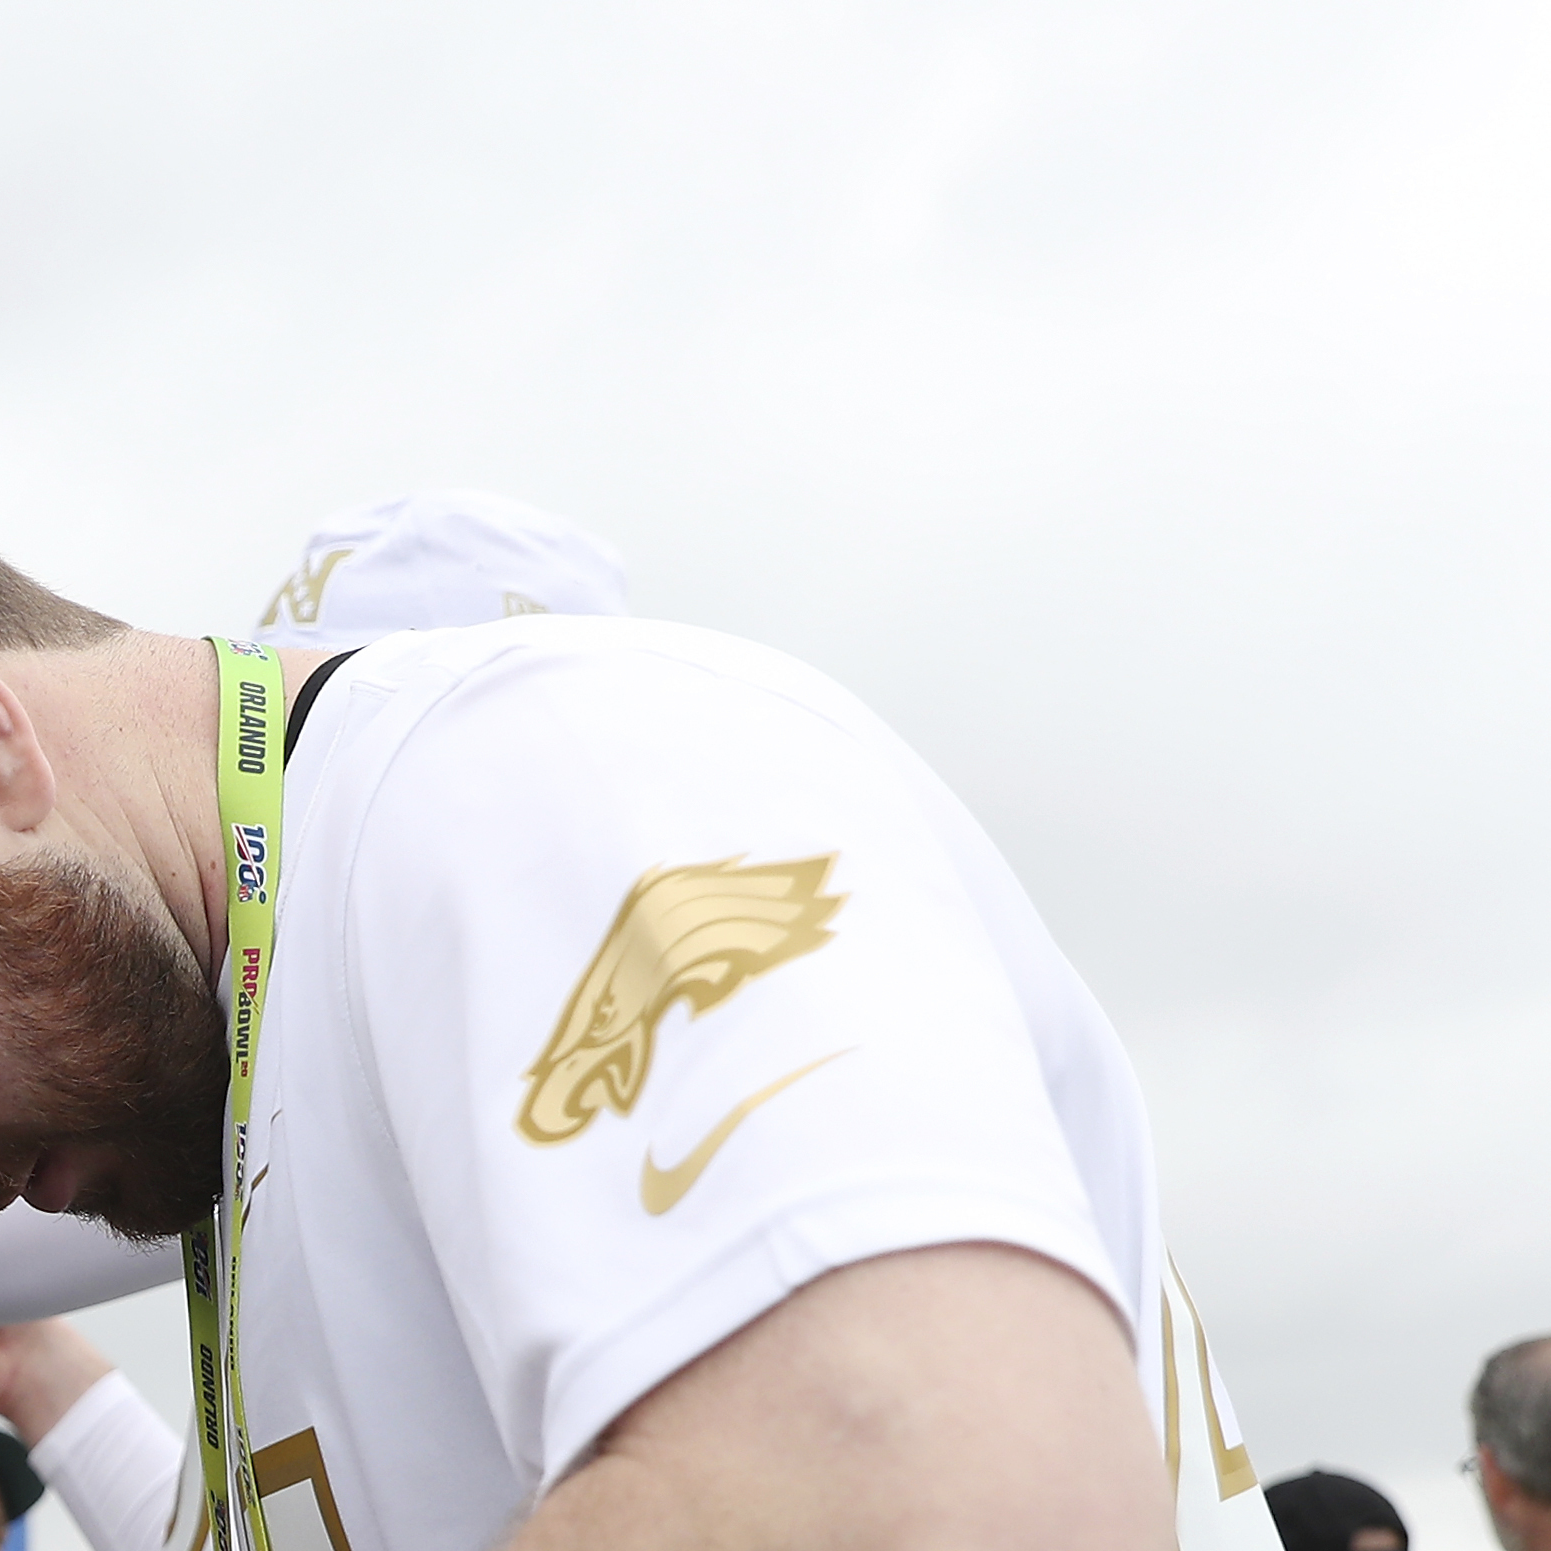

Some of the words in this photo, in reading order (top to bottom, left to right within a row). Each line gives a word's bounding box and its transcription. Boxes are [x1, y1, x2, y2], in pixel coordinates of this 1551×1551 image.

[238, 681, 266, 774] ORLANDO
[243, 948, 261, 999] PRO
[236, 989, 250, 1064] BOWL
[200, 1343, 220, 1450] ORLANDO
